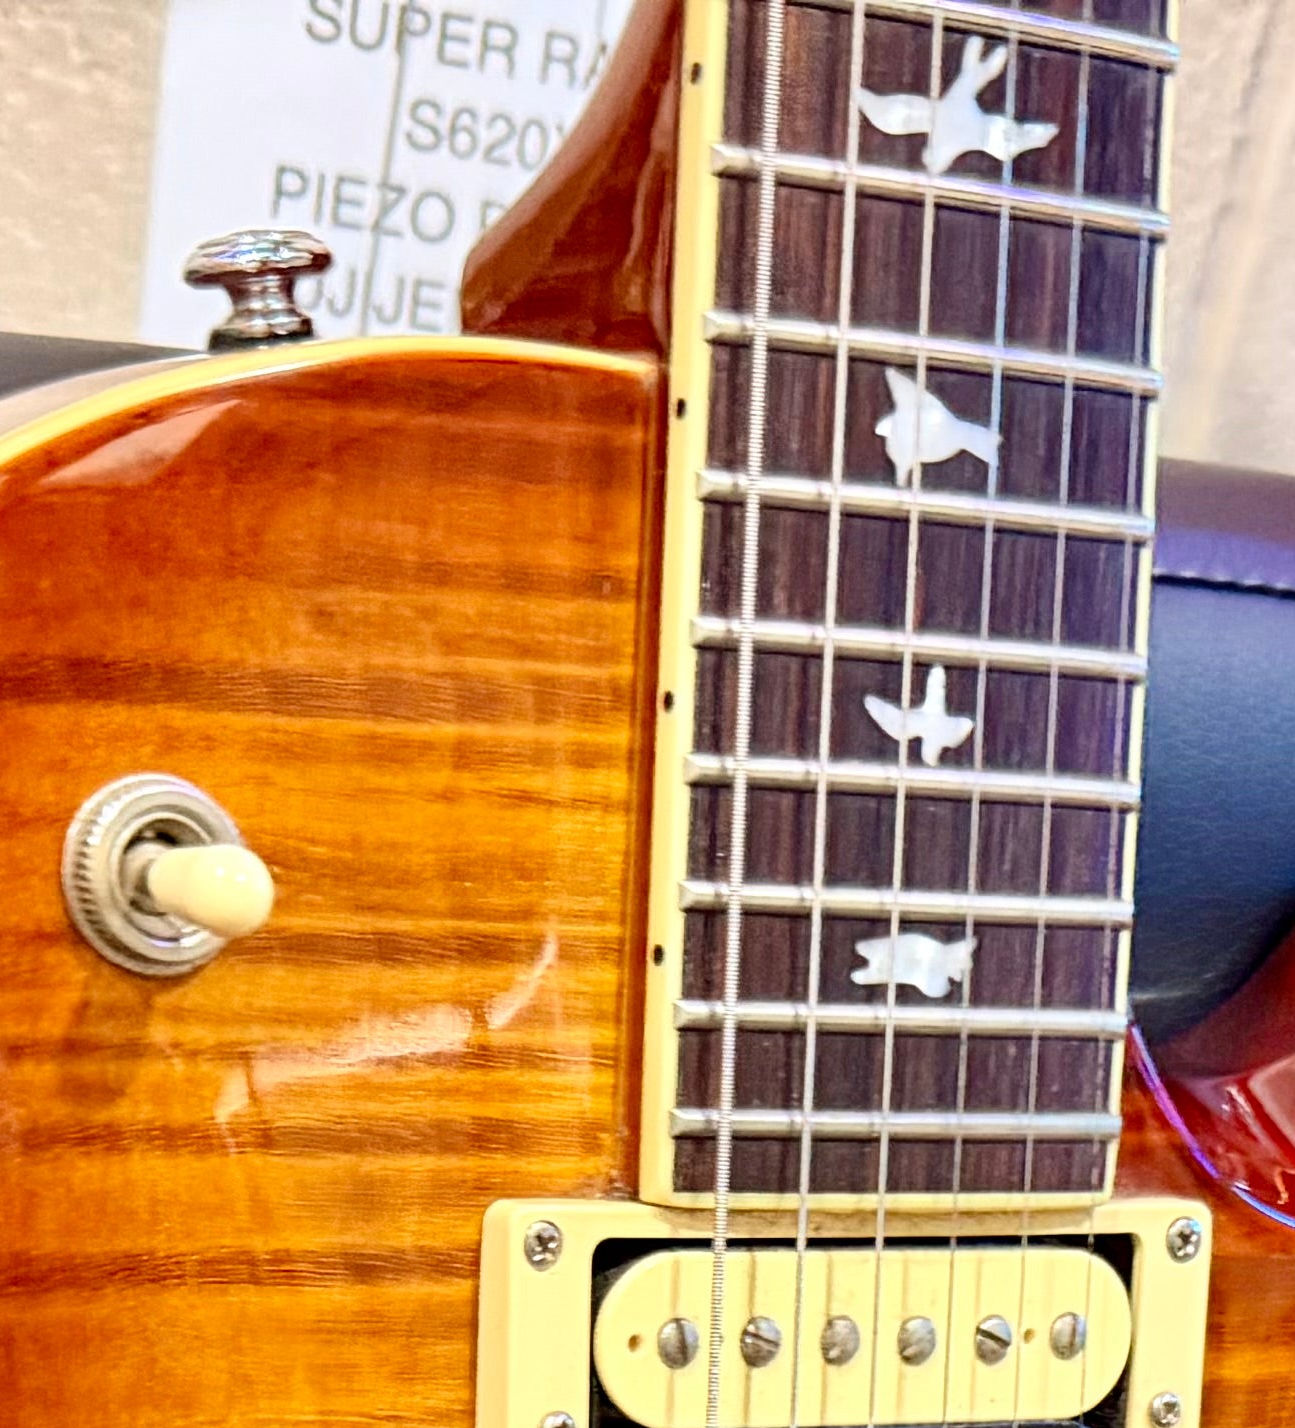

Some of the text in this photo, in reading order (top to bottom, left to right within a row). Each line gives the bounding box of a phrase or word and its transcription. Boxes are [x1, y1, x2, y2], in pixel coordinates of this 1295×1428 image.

[303, 0, 517, 80] SUPER
[405, 97, 566, 171] S620
[271, 164, 456, 244] PIEZO
